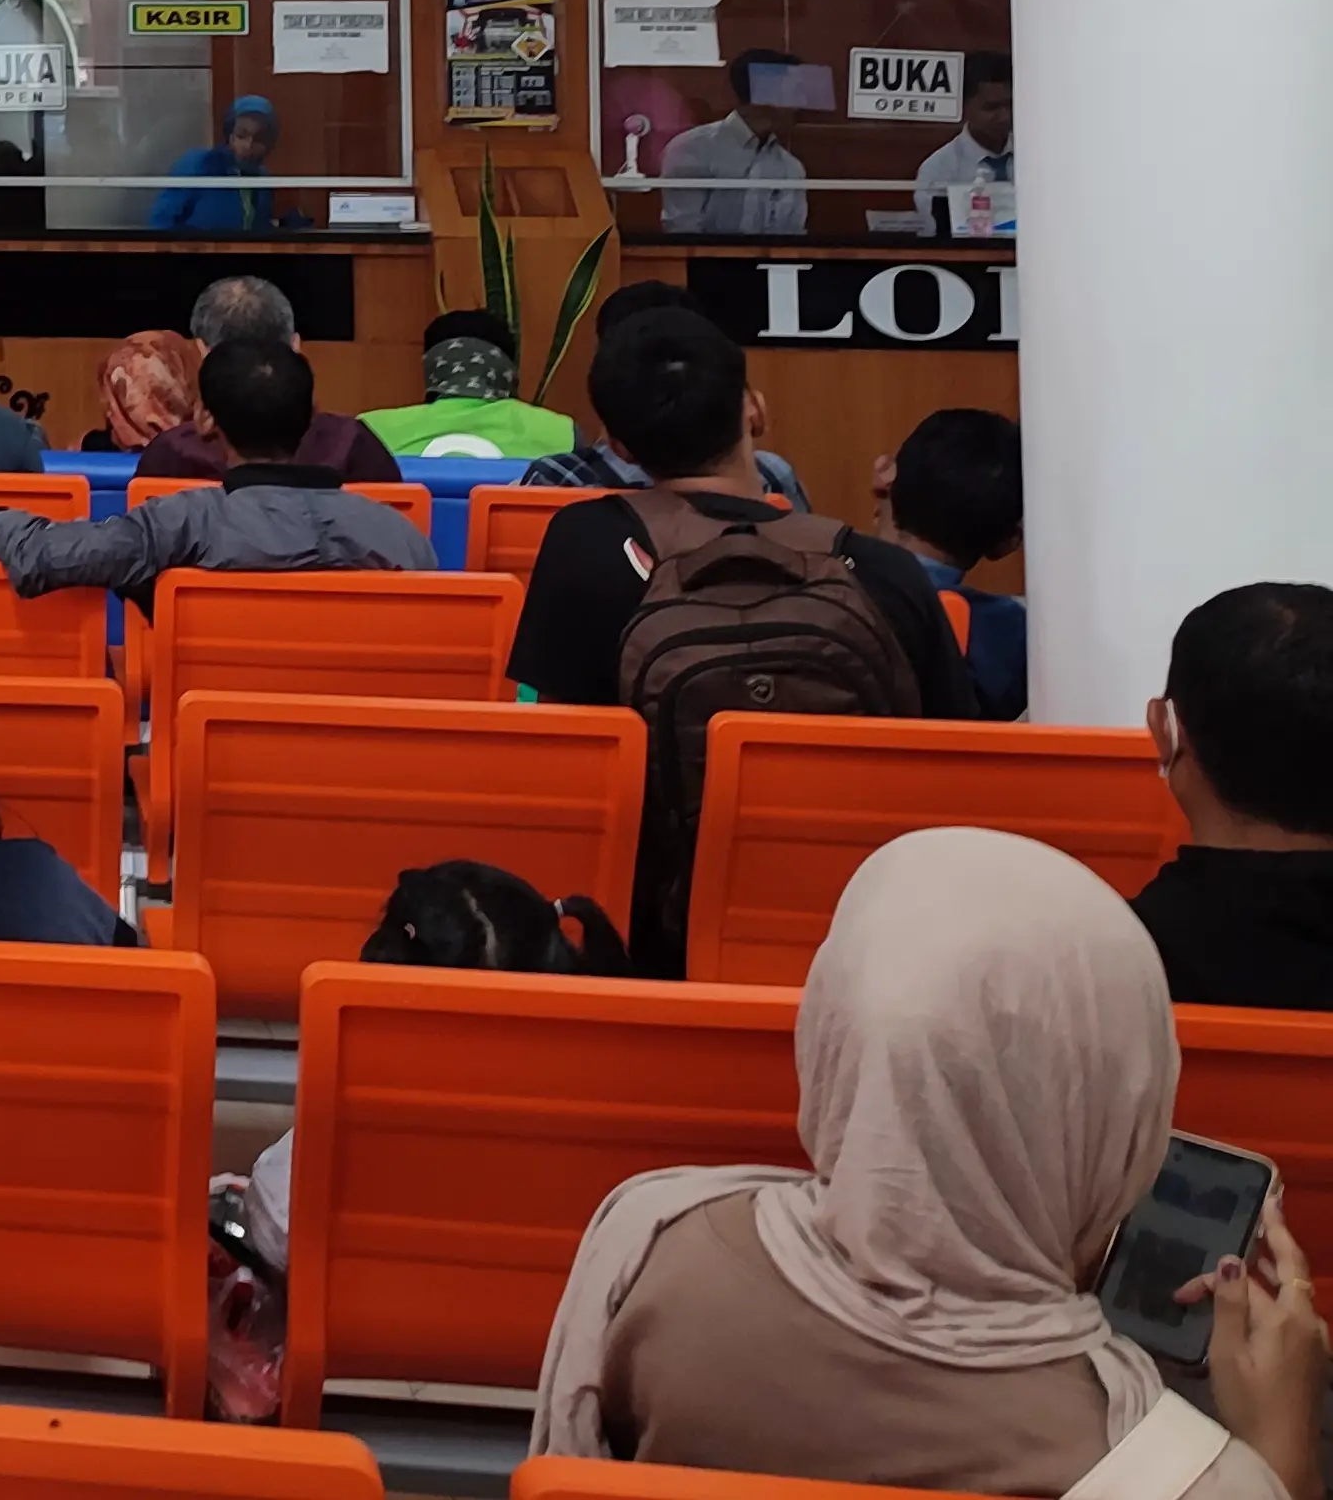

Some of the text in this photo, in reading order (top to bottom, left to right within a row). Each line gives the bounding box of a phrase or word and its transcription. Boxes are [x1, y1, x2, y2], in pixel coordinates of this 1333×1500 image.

[145, 9, 232, 26] KASIR
[859, 57, 952, 93] BUKA
[874, 99, 937, 113] OPEN
